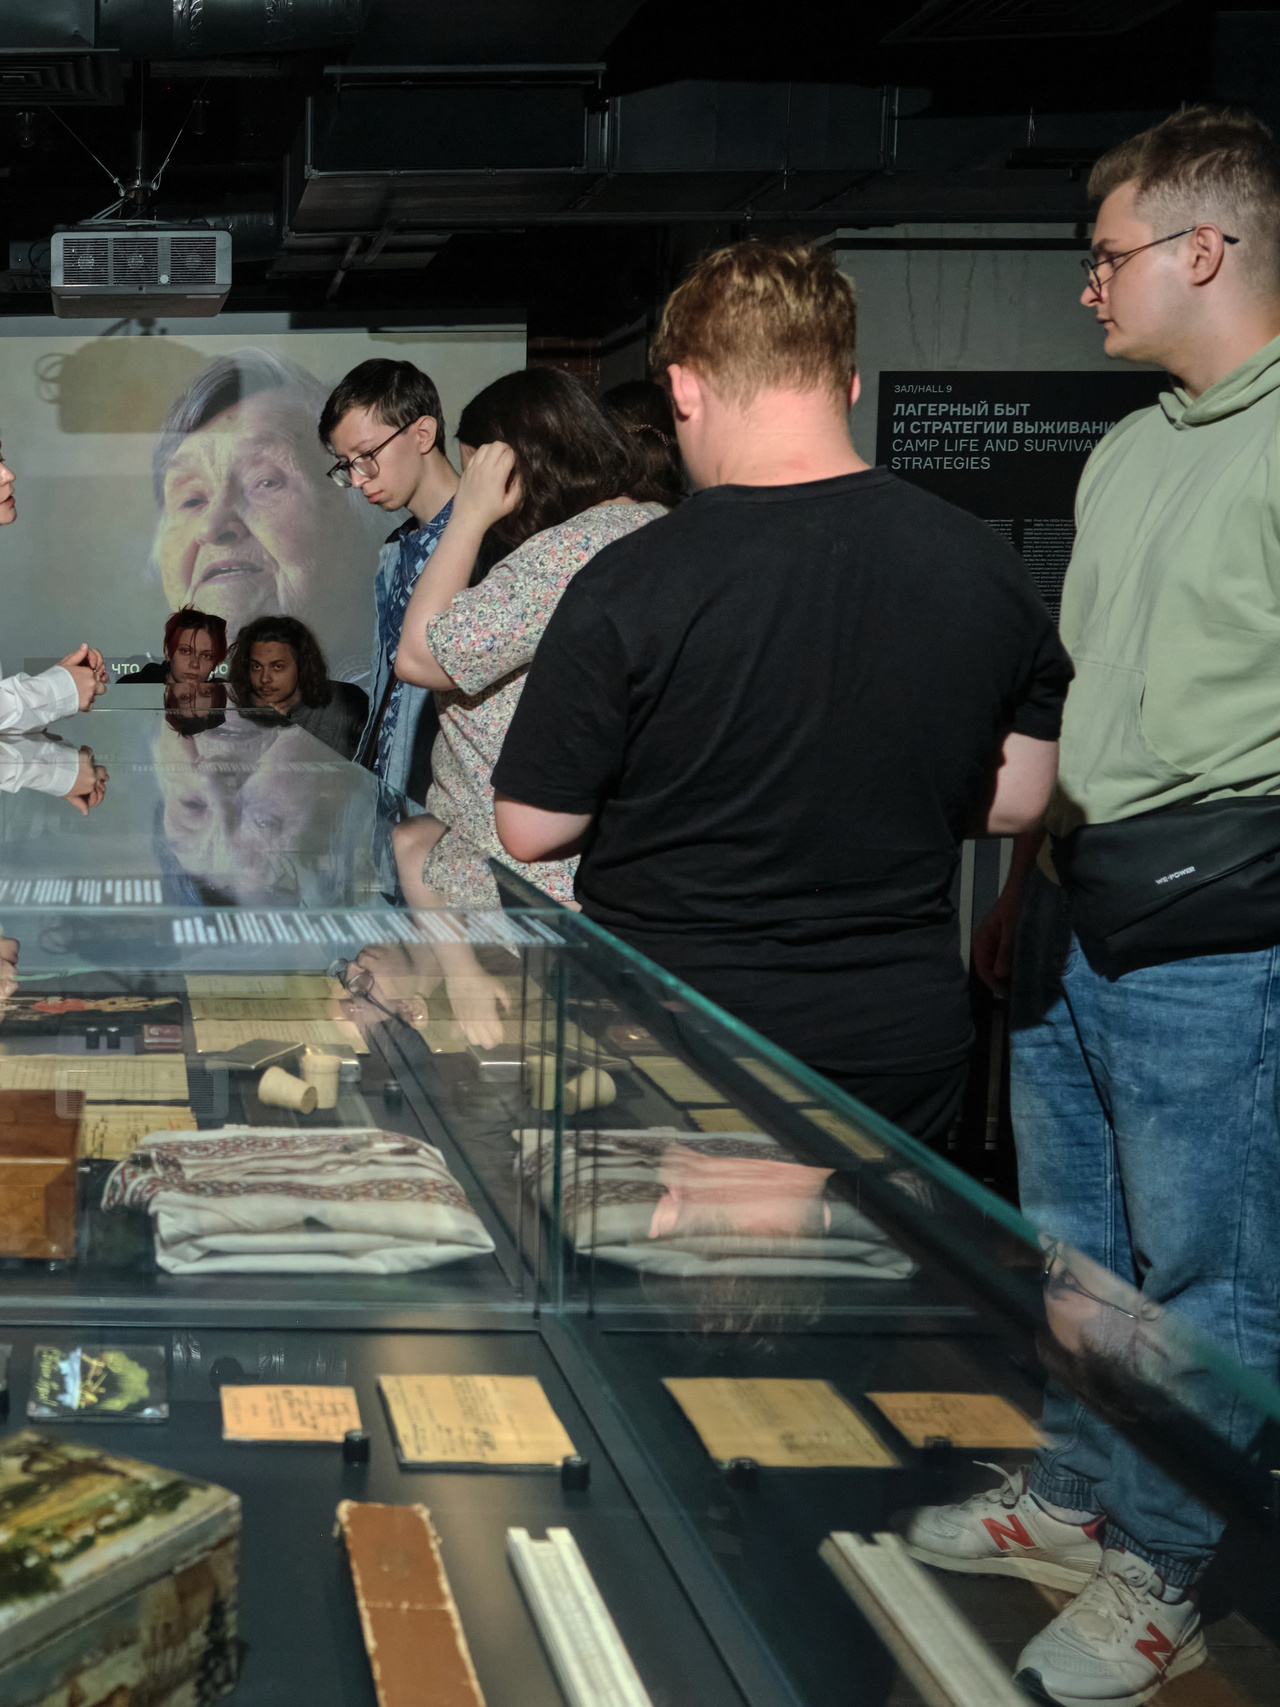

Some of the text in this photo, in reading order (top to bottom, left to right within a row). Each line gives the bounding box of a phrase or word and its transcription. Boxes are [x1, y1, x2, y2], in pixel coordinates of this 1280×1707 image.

[894, 384, 953, 394] ЗАЛ/HALL 9
[893, 400, 1031, 416] ЛАГЕРНЫЙ БЫТ
[893, 421, 905, 434] И
[909, 421, 1007, 434] СТРАТЕГИИ
[892, 438, 1098, 452] CAMP LIFE AND SURVIVA
[891, 456, 991, 470] STRATEGIES
[981, 1513, 1037, 1552] N
[1134, 1621, 1175, 1675] N
